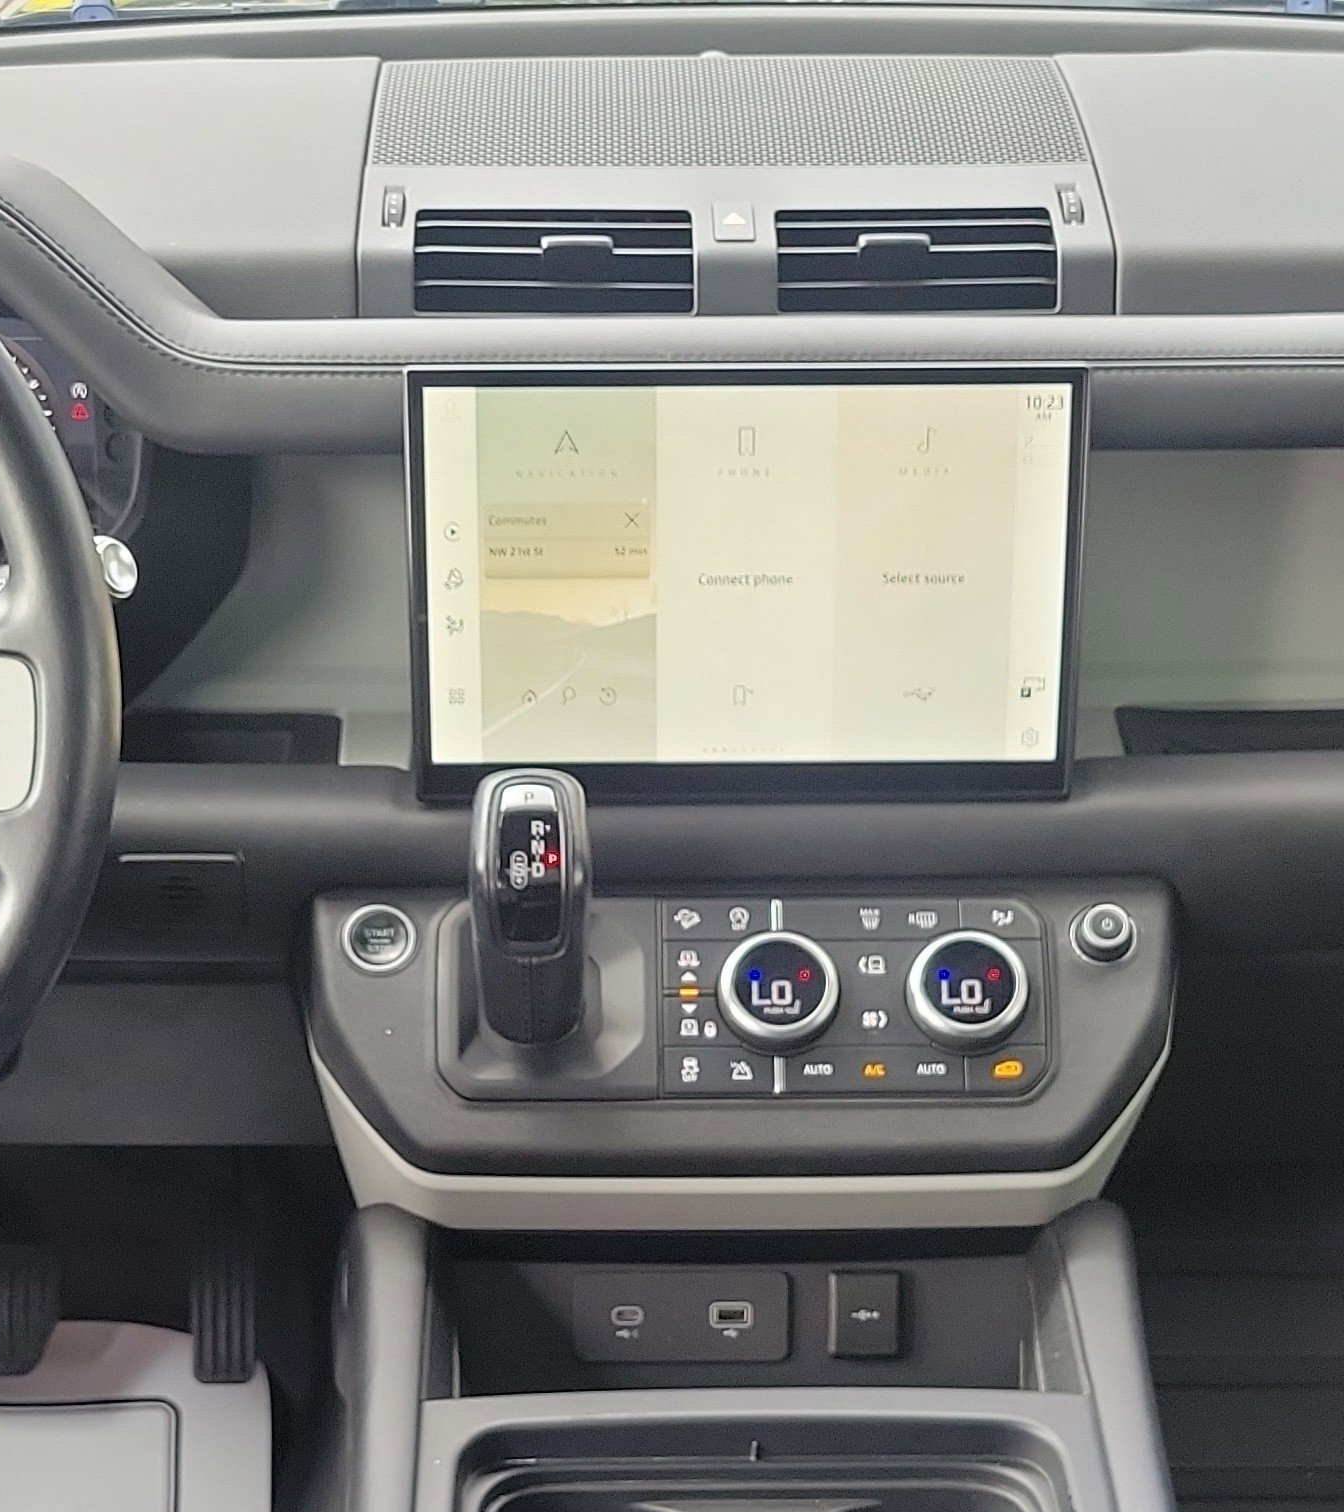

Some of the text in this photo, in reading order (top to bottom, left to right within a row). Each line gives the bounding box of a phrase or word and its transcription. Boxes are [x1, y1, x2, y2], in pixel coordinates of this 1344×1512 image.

[698, 572, 794, 589] Connect phone
[882, 571, 966, 585] Select source
[531, 820, 545, 836] R
[531, 839, 545, 855] N
[547, 851, 558, 864] P
[531, 862, 545, 878] D
[803, 1063, 835, 1076] AUTO
[864, 1063, 886, 1077] A/C
[916, 1062, 948, 1076] AUTO
